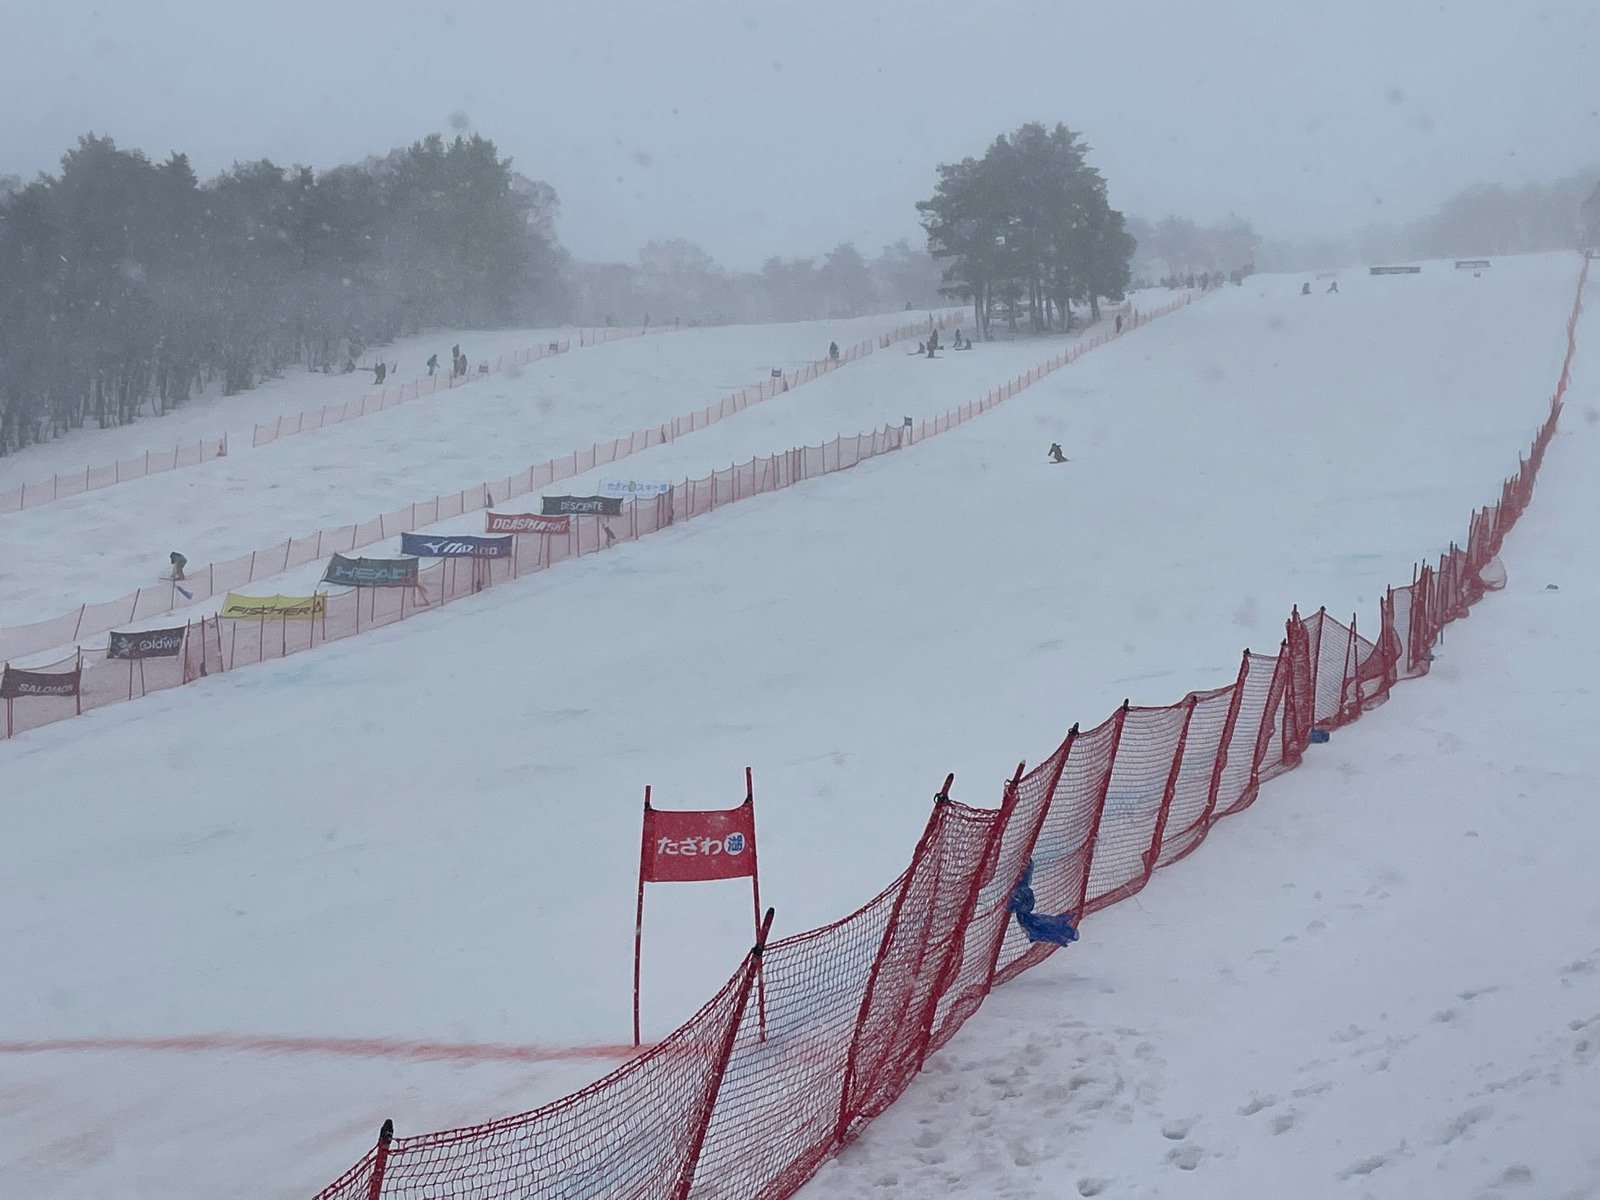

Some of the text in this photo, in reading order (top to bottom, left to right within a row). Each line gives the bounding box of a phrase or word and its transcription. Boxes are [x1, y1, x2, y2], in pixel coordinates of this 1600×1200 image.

[560, 501, 603, 511] DESCENTE
[228, 605, 311, 615] FISCHER
[656, 834, 743, 856] たざわ湖
